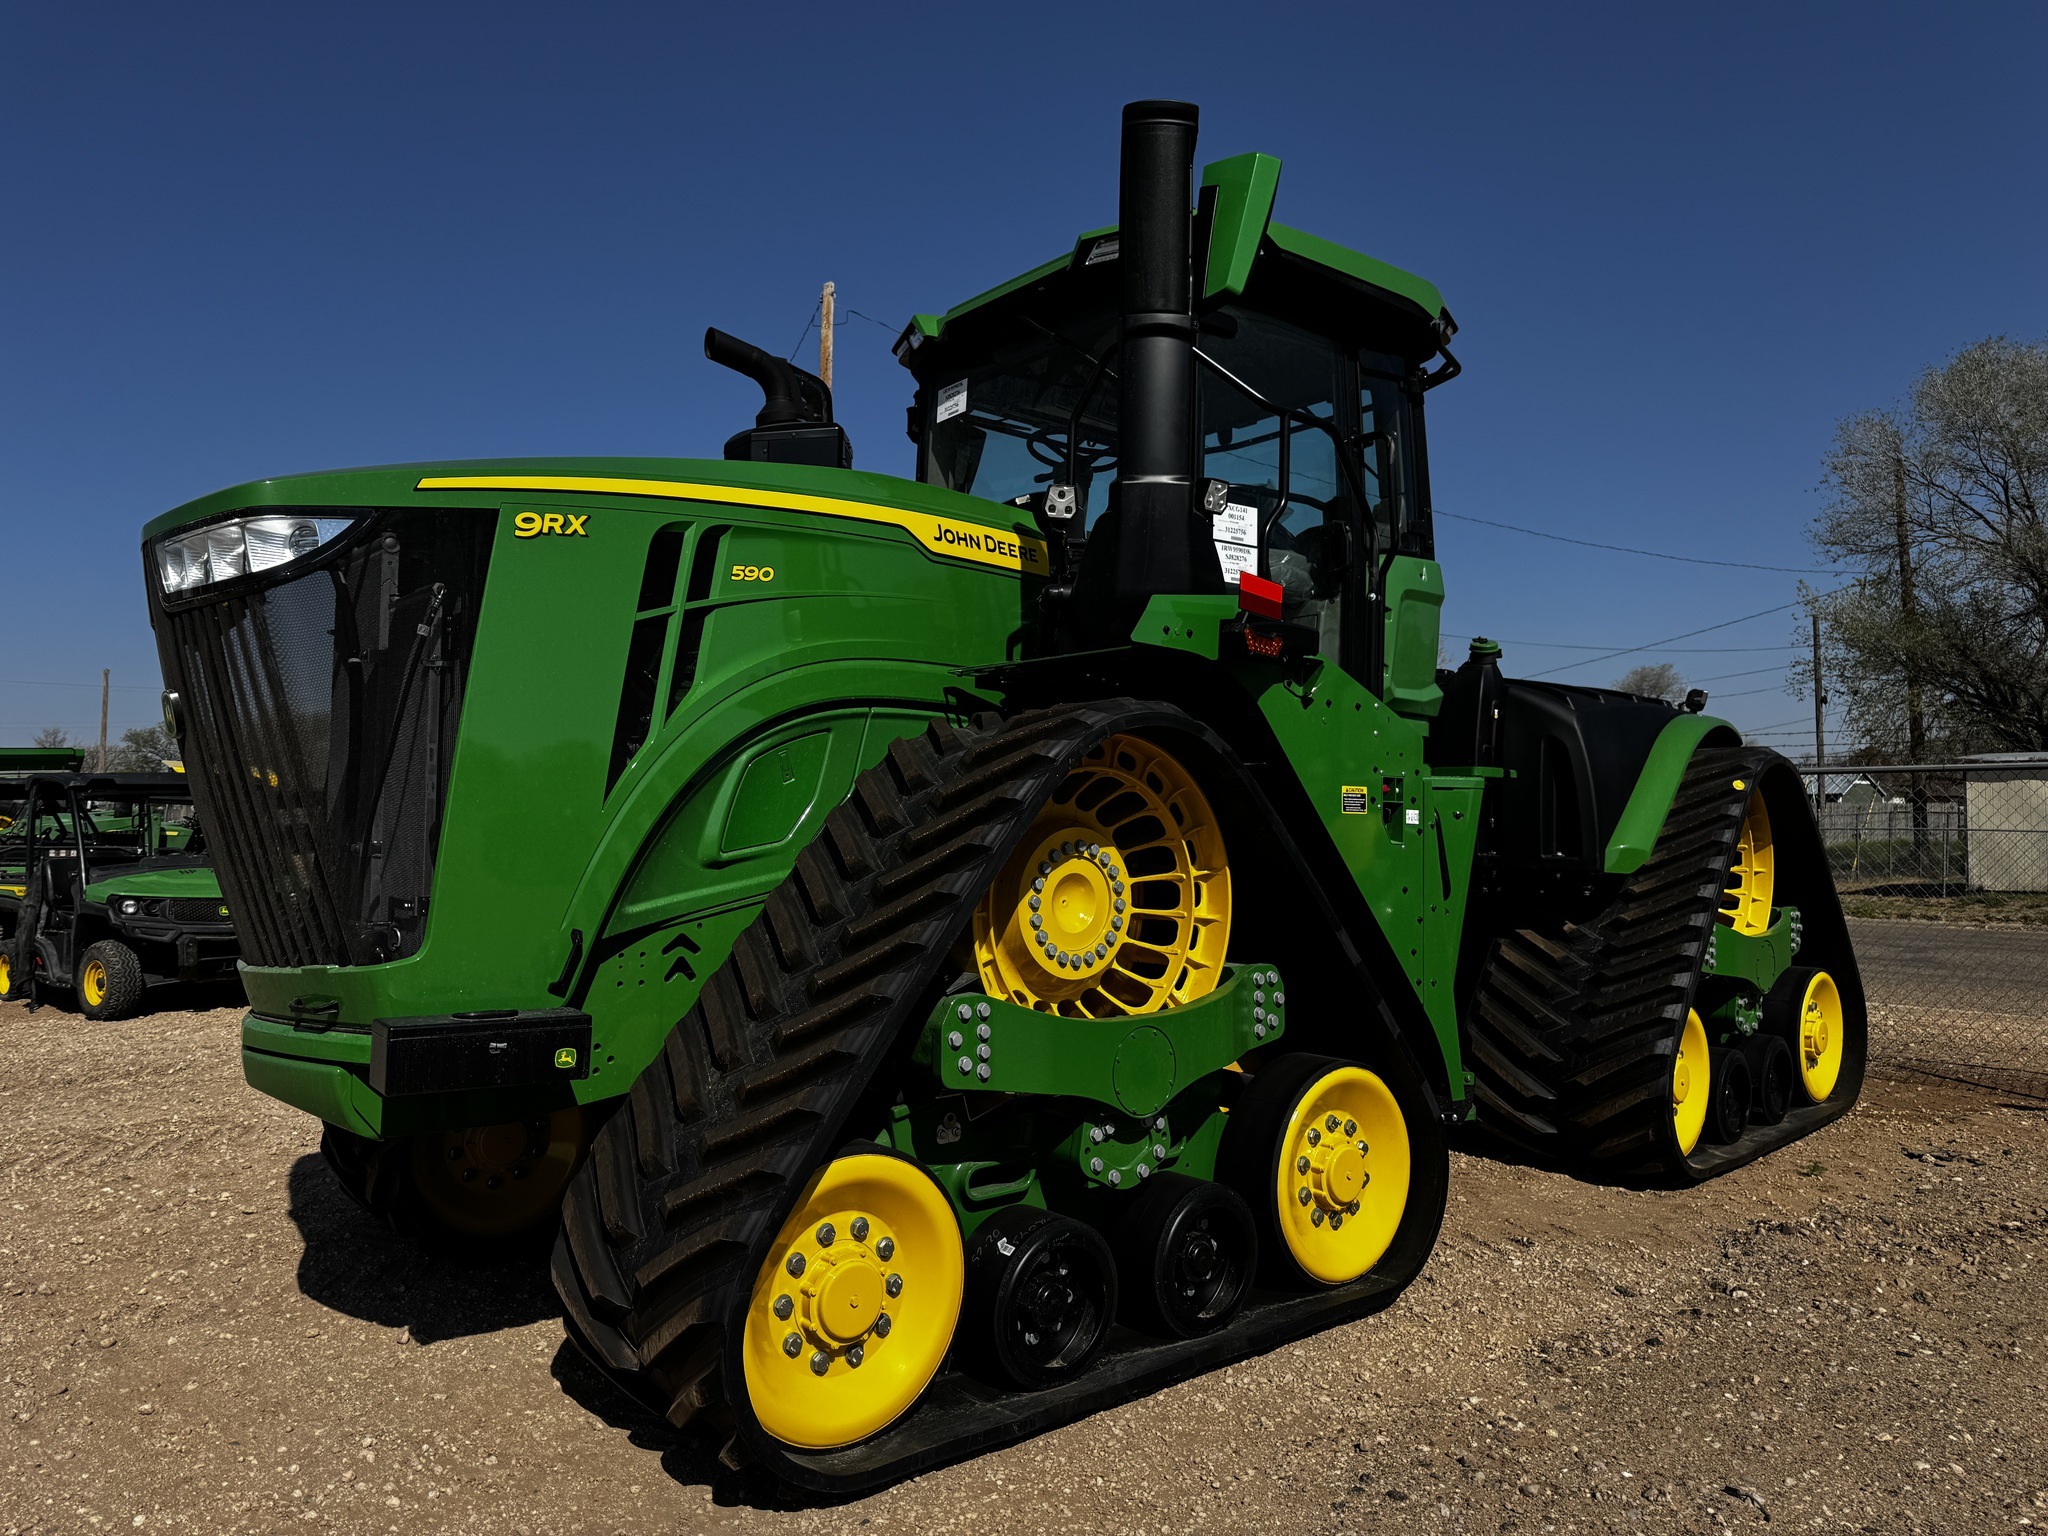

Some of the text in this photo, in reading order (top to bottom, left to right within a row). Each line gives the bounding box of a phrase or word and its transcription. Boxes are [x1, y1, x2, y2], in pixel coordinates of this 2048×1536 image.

[514, 511, 590, 538] 9RX
[933, 523, 1039, 563] JOHN DEERE
[731, 565, 775, 582] 590
